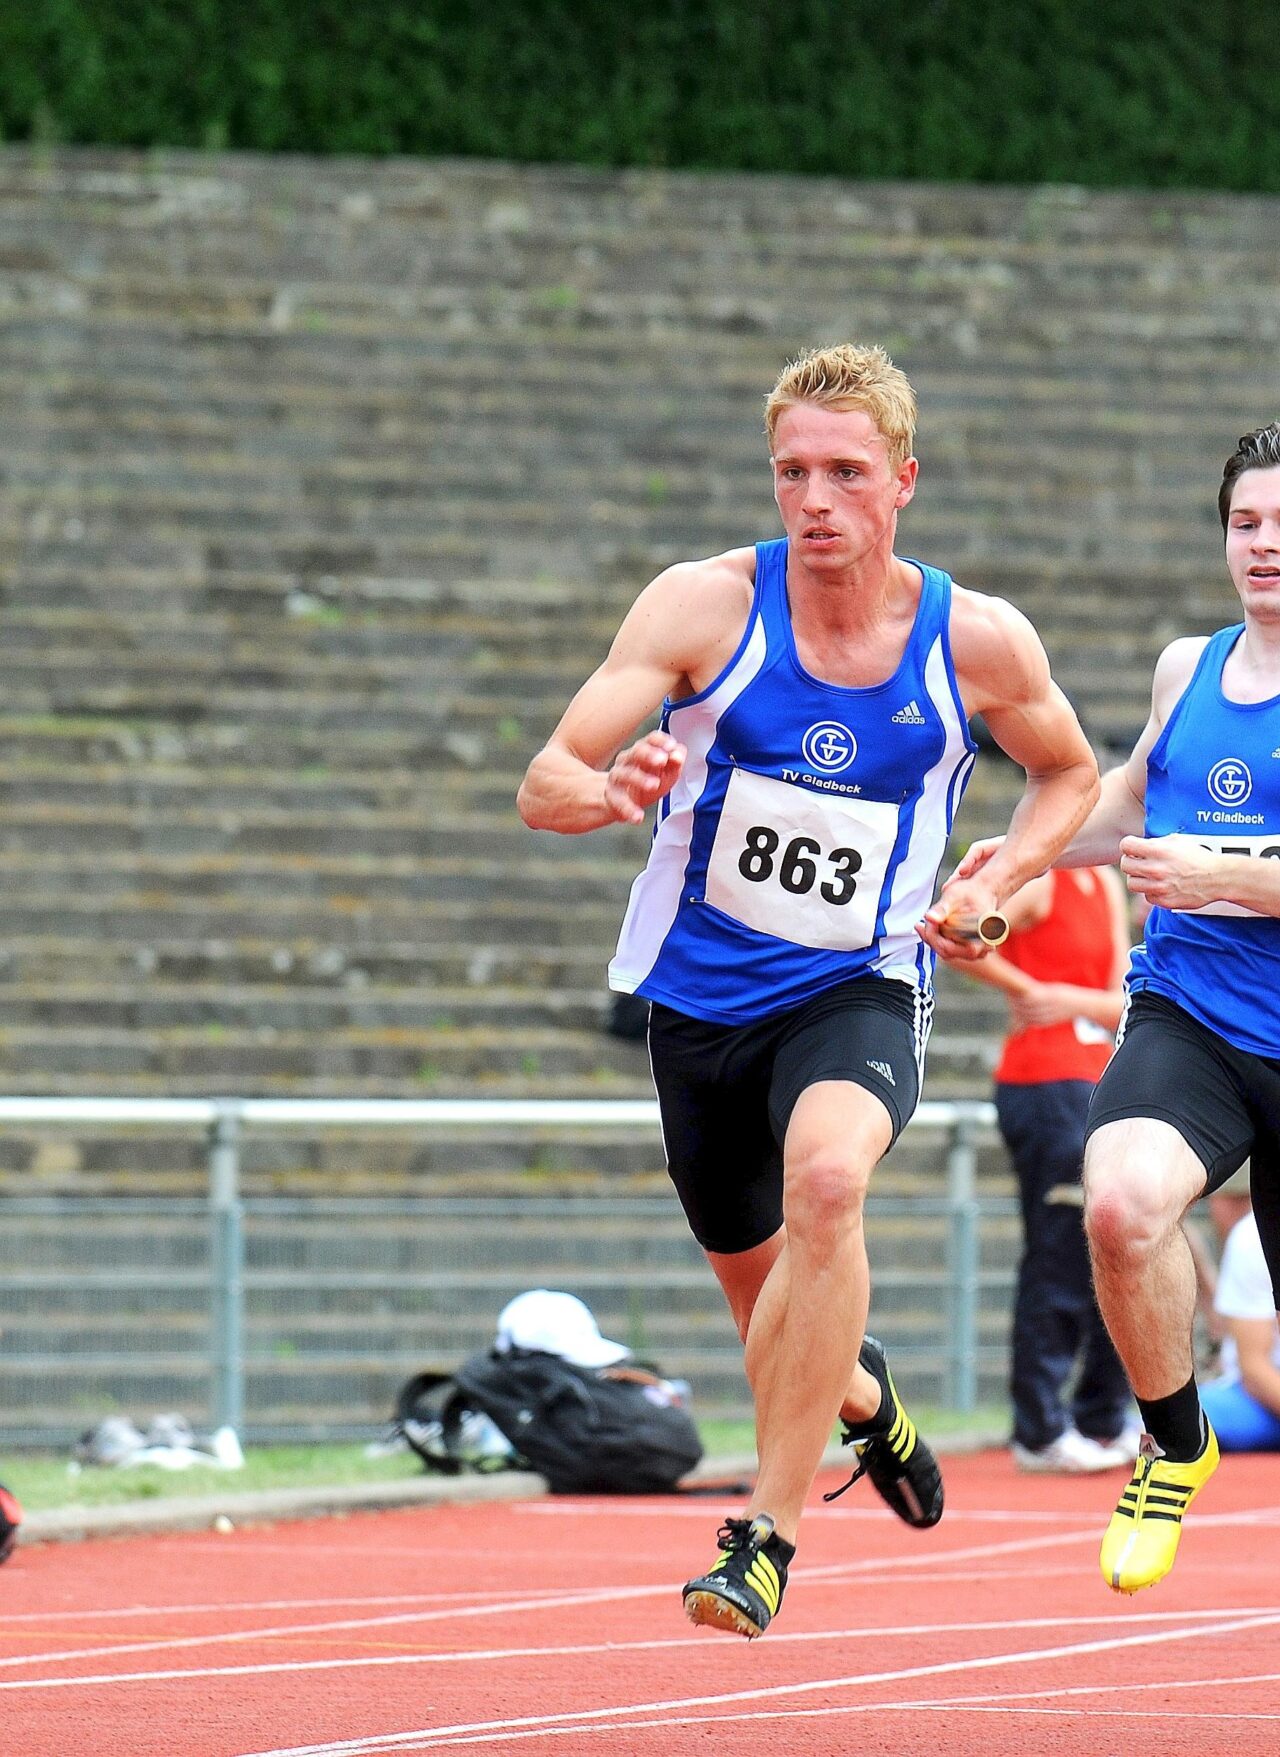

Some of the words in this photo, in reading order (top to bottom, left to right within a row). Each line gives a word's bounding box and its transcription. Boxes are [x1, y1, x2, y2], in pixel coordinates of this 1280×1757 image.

[892, 715, 925, 725] adidas
[782, 768, 800, 782] TV
[802, 774, 862, 793] Gladbeck
[1196, 811, 1211, 822] TV
[1213, 811, 1264, 824] Gladbeck
[738, 826, 862, 906] 863
